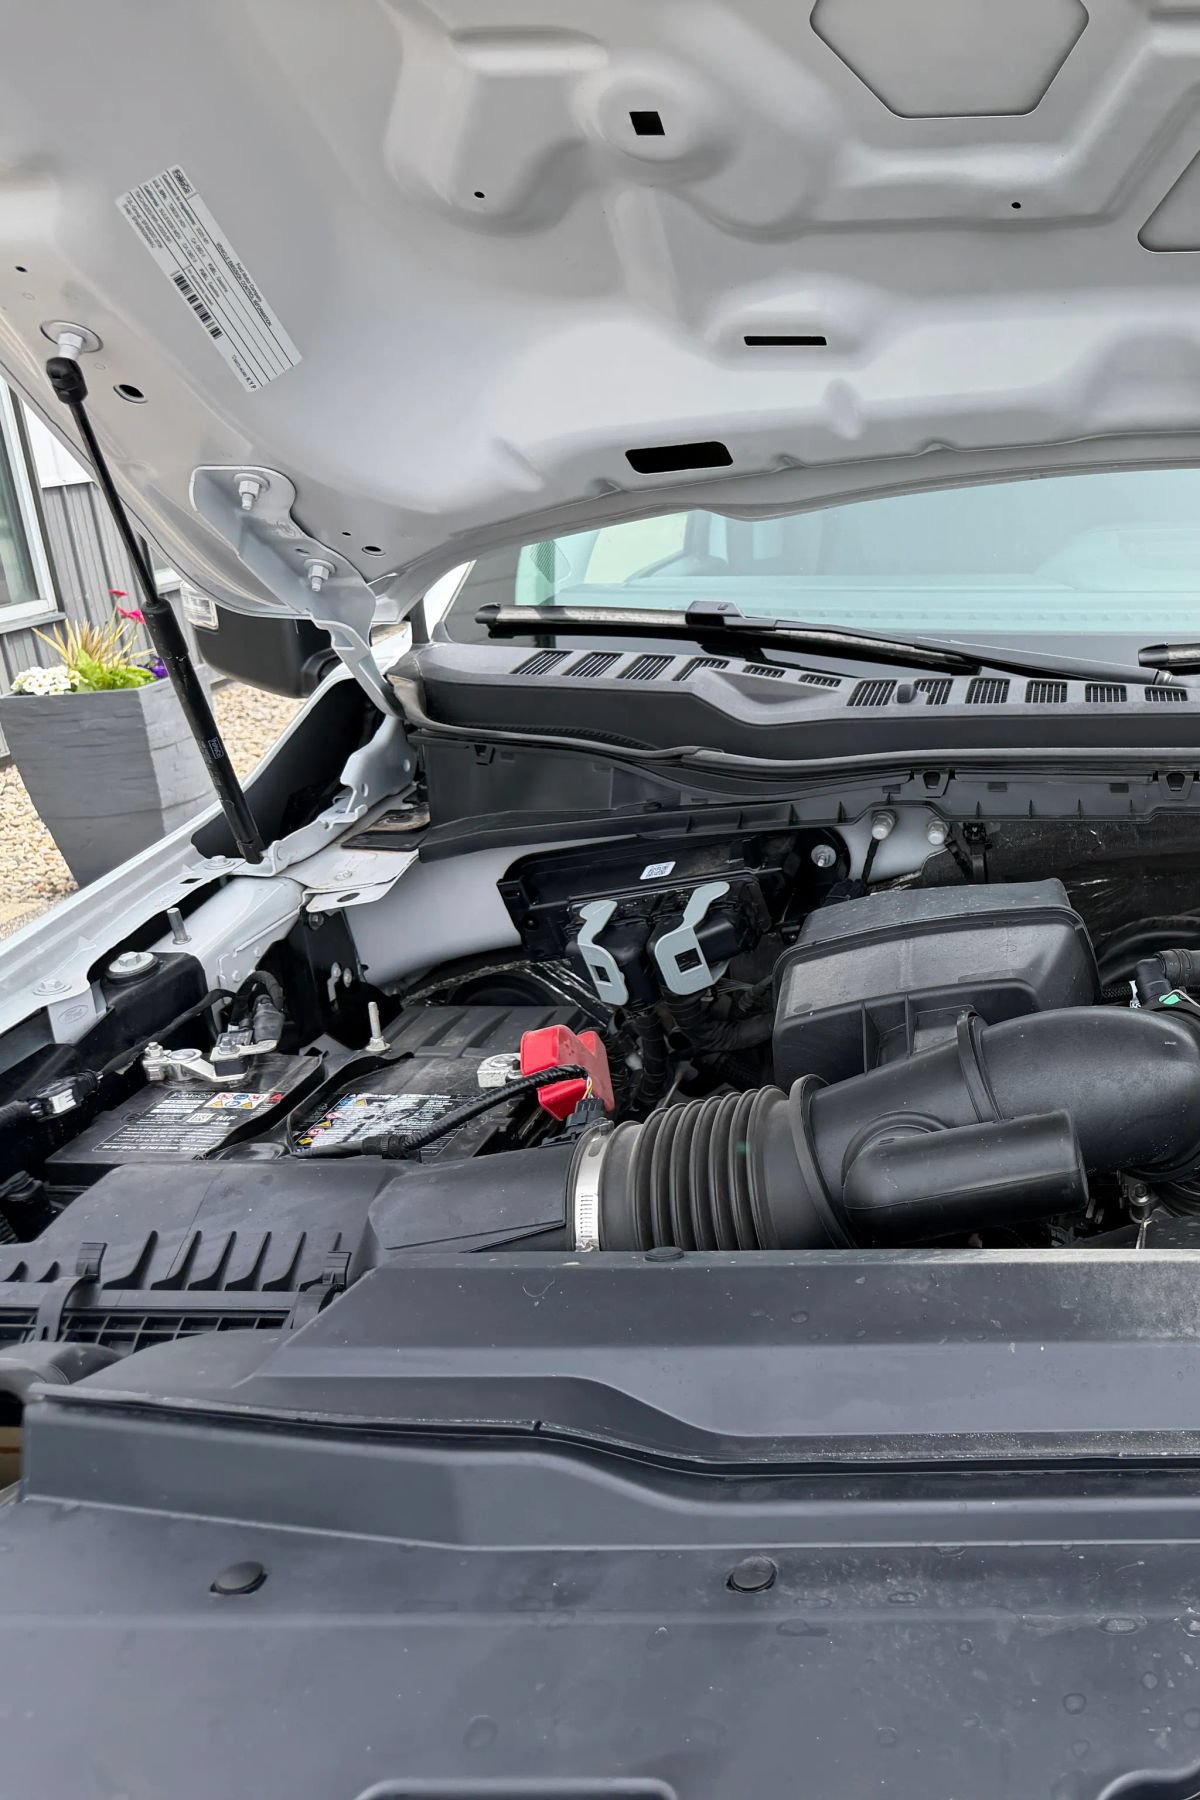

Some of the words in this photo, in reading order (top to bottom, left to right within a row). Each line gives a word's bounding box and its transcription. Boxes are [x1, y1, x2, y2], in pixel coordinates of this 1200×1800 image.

[171, 167, 193, 194] FoMoCo
[215, 241, 230, 260] VEHICLE
[226, 259, 243, 281] EMISSION
[239, 279, 255, 299] CONTROL
[251, 298, 273, 327] INFORMATION
[234, 261, 244, 273] Ford
[240, 271, 252, 285] Motor
[247, 282, 263, 303] Company
